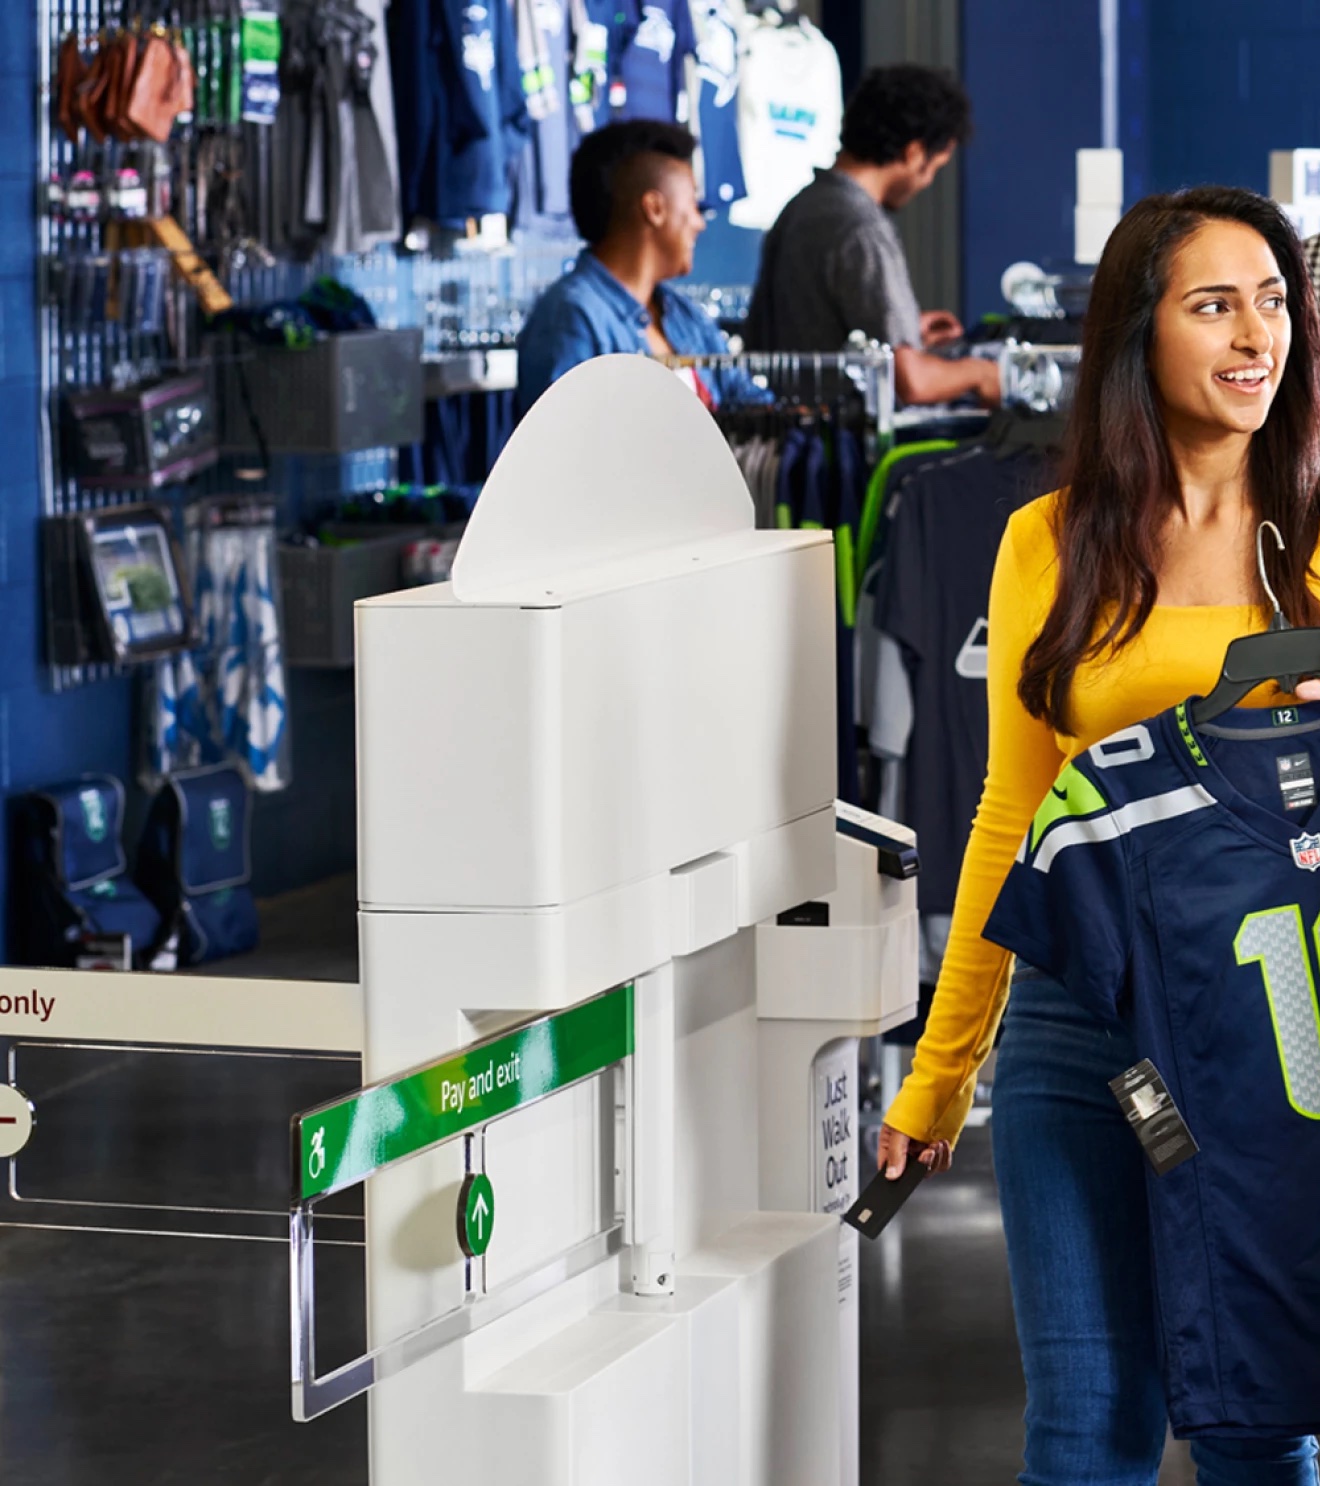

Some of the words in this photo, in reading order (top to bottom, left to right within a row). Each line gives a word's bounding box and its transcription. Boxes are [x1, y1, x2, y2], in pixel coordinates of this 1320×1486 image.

[1277, 710, 1292, 723] 12
[0, 989, 56, 1022] only
[441, 1080, 466, 1114] Pay
[468, 1059, 493, 1100] and
[496, 1051, 520, 1088] exit
[824, 1071, 848, 1109] Just
[822, 1107, 851, 1150] Walk
[826, 1151, 848, 1189] Out
